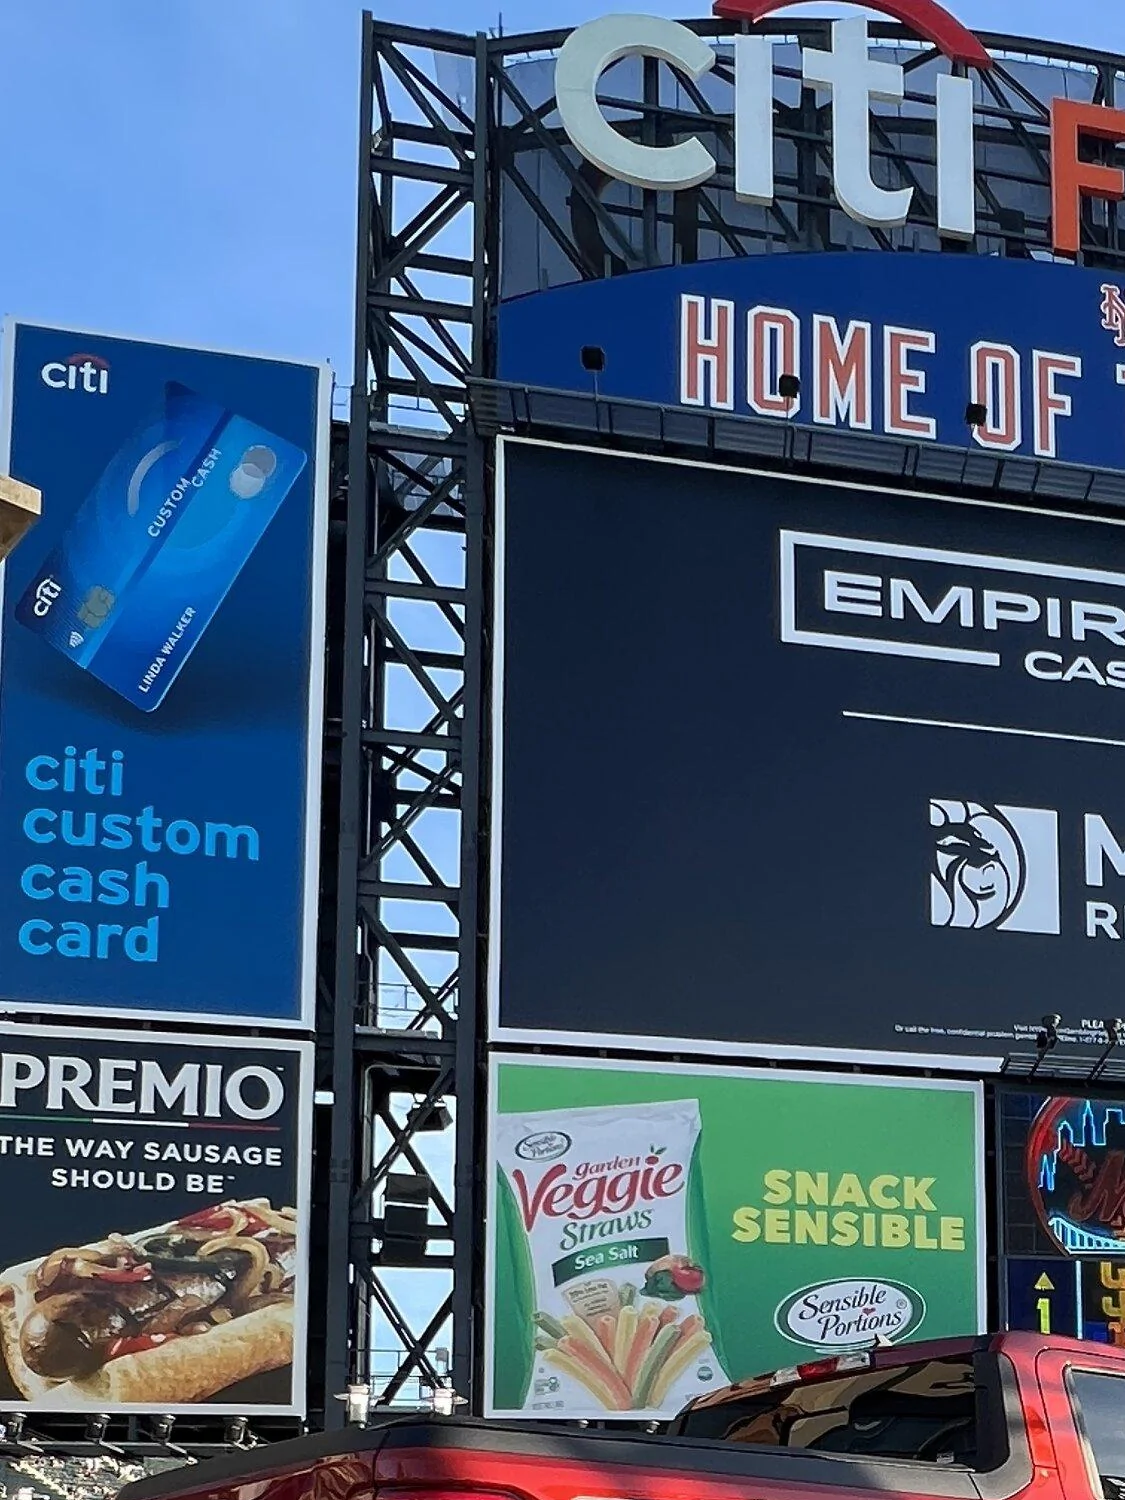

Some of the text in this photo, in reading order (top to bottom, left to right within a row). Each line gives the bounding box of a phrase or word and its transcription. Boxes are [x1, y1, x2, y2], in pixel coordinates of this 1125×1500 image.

[554, 12, 974, 242] citi
[41, 357, 110, 395] citi
[680, 293, 937, 440] HOME
[970, 341, 1082, 459] OF
[190, 447, 223, 489] CASH
[147, 477, 191, 538] CUSTOM
[33, 577, 63, 617] citi
[138, 606, 197, 693] LINDA WALKER
[25, 745, 125, 797] citi
[22, 805, 260, 861] custom
[20, 860, 170, 908] cash
[18, 915, 160, 963] card
[0, 1052, 286, 1122] PREMIO
[0, 1134, 283, 1167] THE WAY SAUSAGE
[572, 1154, 640, 1181] garden
[51, 1167, 225, 1194] SHOULD BE
[512, 1156, 685, 1232] Veggie
[762, 1168, 938, 1211] SNACK
[560, 1209, 653, 1251] Straws
[731, 1206, 966, 1251] SENSIBLE
[575, 1244, 640, 1271] Sea Salt
[798, 1284, 887, 1321] Sensible
[817, 1309, 902, 1341] Portions
